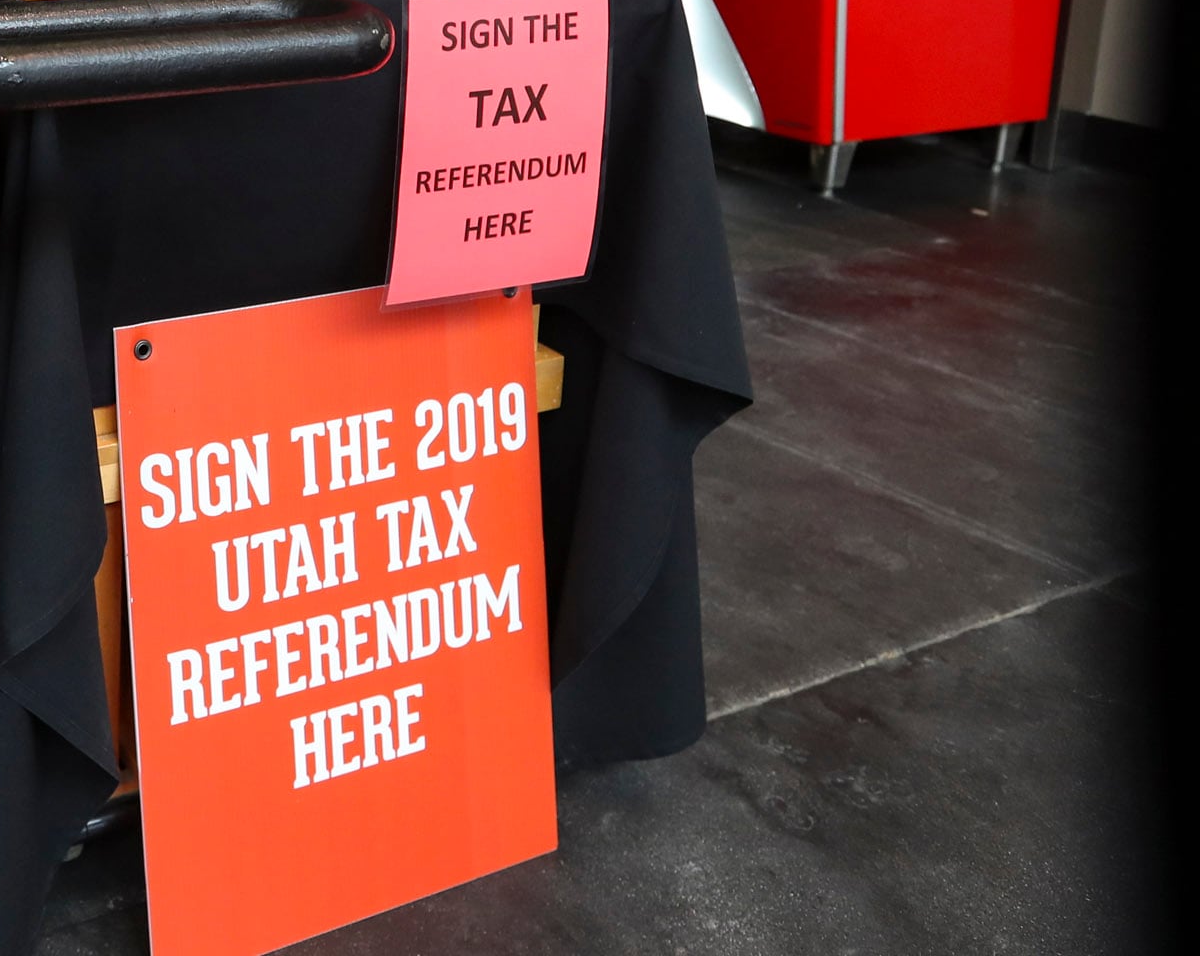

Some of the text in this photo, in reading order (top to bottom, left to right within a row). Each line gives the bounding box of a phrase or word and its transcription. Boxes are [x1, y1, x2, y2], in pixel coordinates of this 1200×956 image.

[441, 11, 578, 52] SIGN THE
[468, 83, 548, 129] TAX
[415, 151, 587, 194] REFERENDUM
[463, 209, 534, 242] HERE
[139, 381, 527, 529] SIGN THE 2019
[211, 483, 478, 612] UTAH TAX
[166, 563, 523, 726] REFERENDUM
[289, 683, 426, 790] HERE
